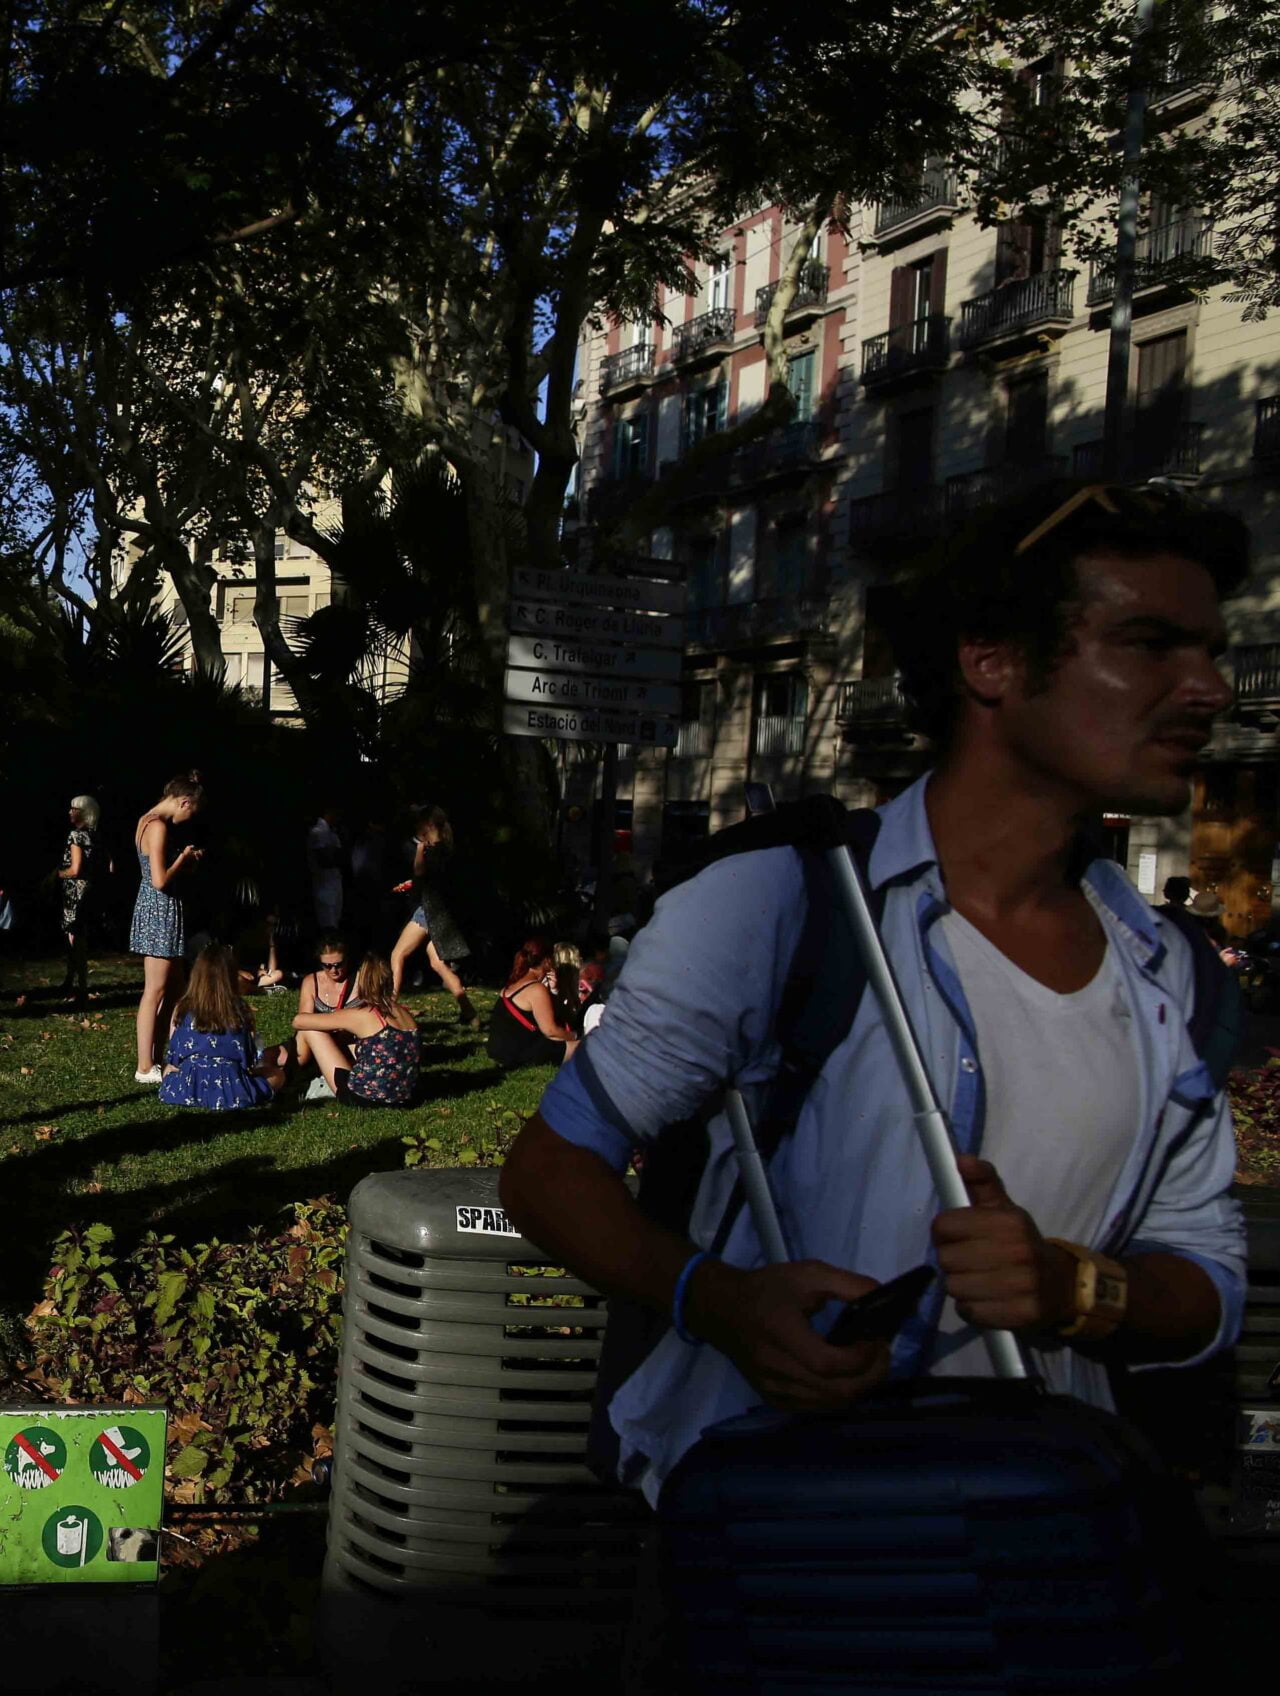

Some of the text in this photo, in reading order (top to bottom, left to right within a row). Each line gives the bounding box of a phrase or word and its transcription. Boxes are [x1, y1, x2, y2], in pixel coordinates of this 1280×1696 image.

[535, 608, 551, 625] C.
[554, 611, 598, 633] Roger
[602, 616, 620, 632] de
[533, 642, 619, 668] C. Trafalgar
[531, 676, 556, 695] Arc
[561, 679, 578, 697] de
[527, 711, 636, 736] Estació del Nord
